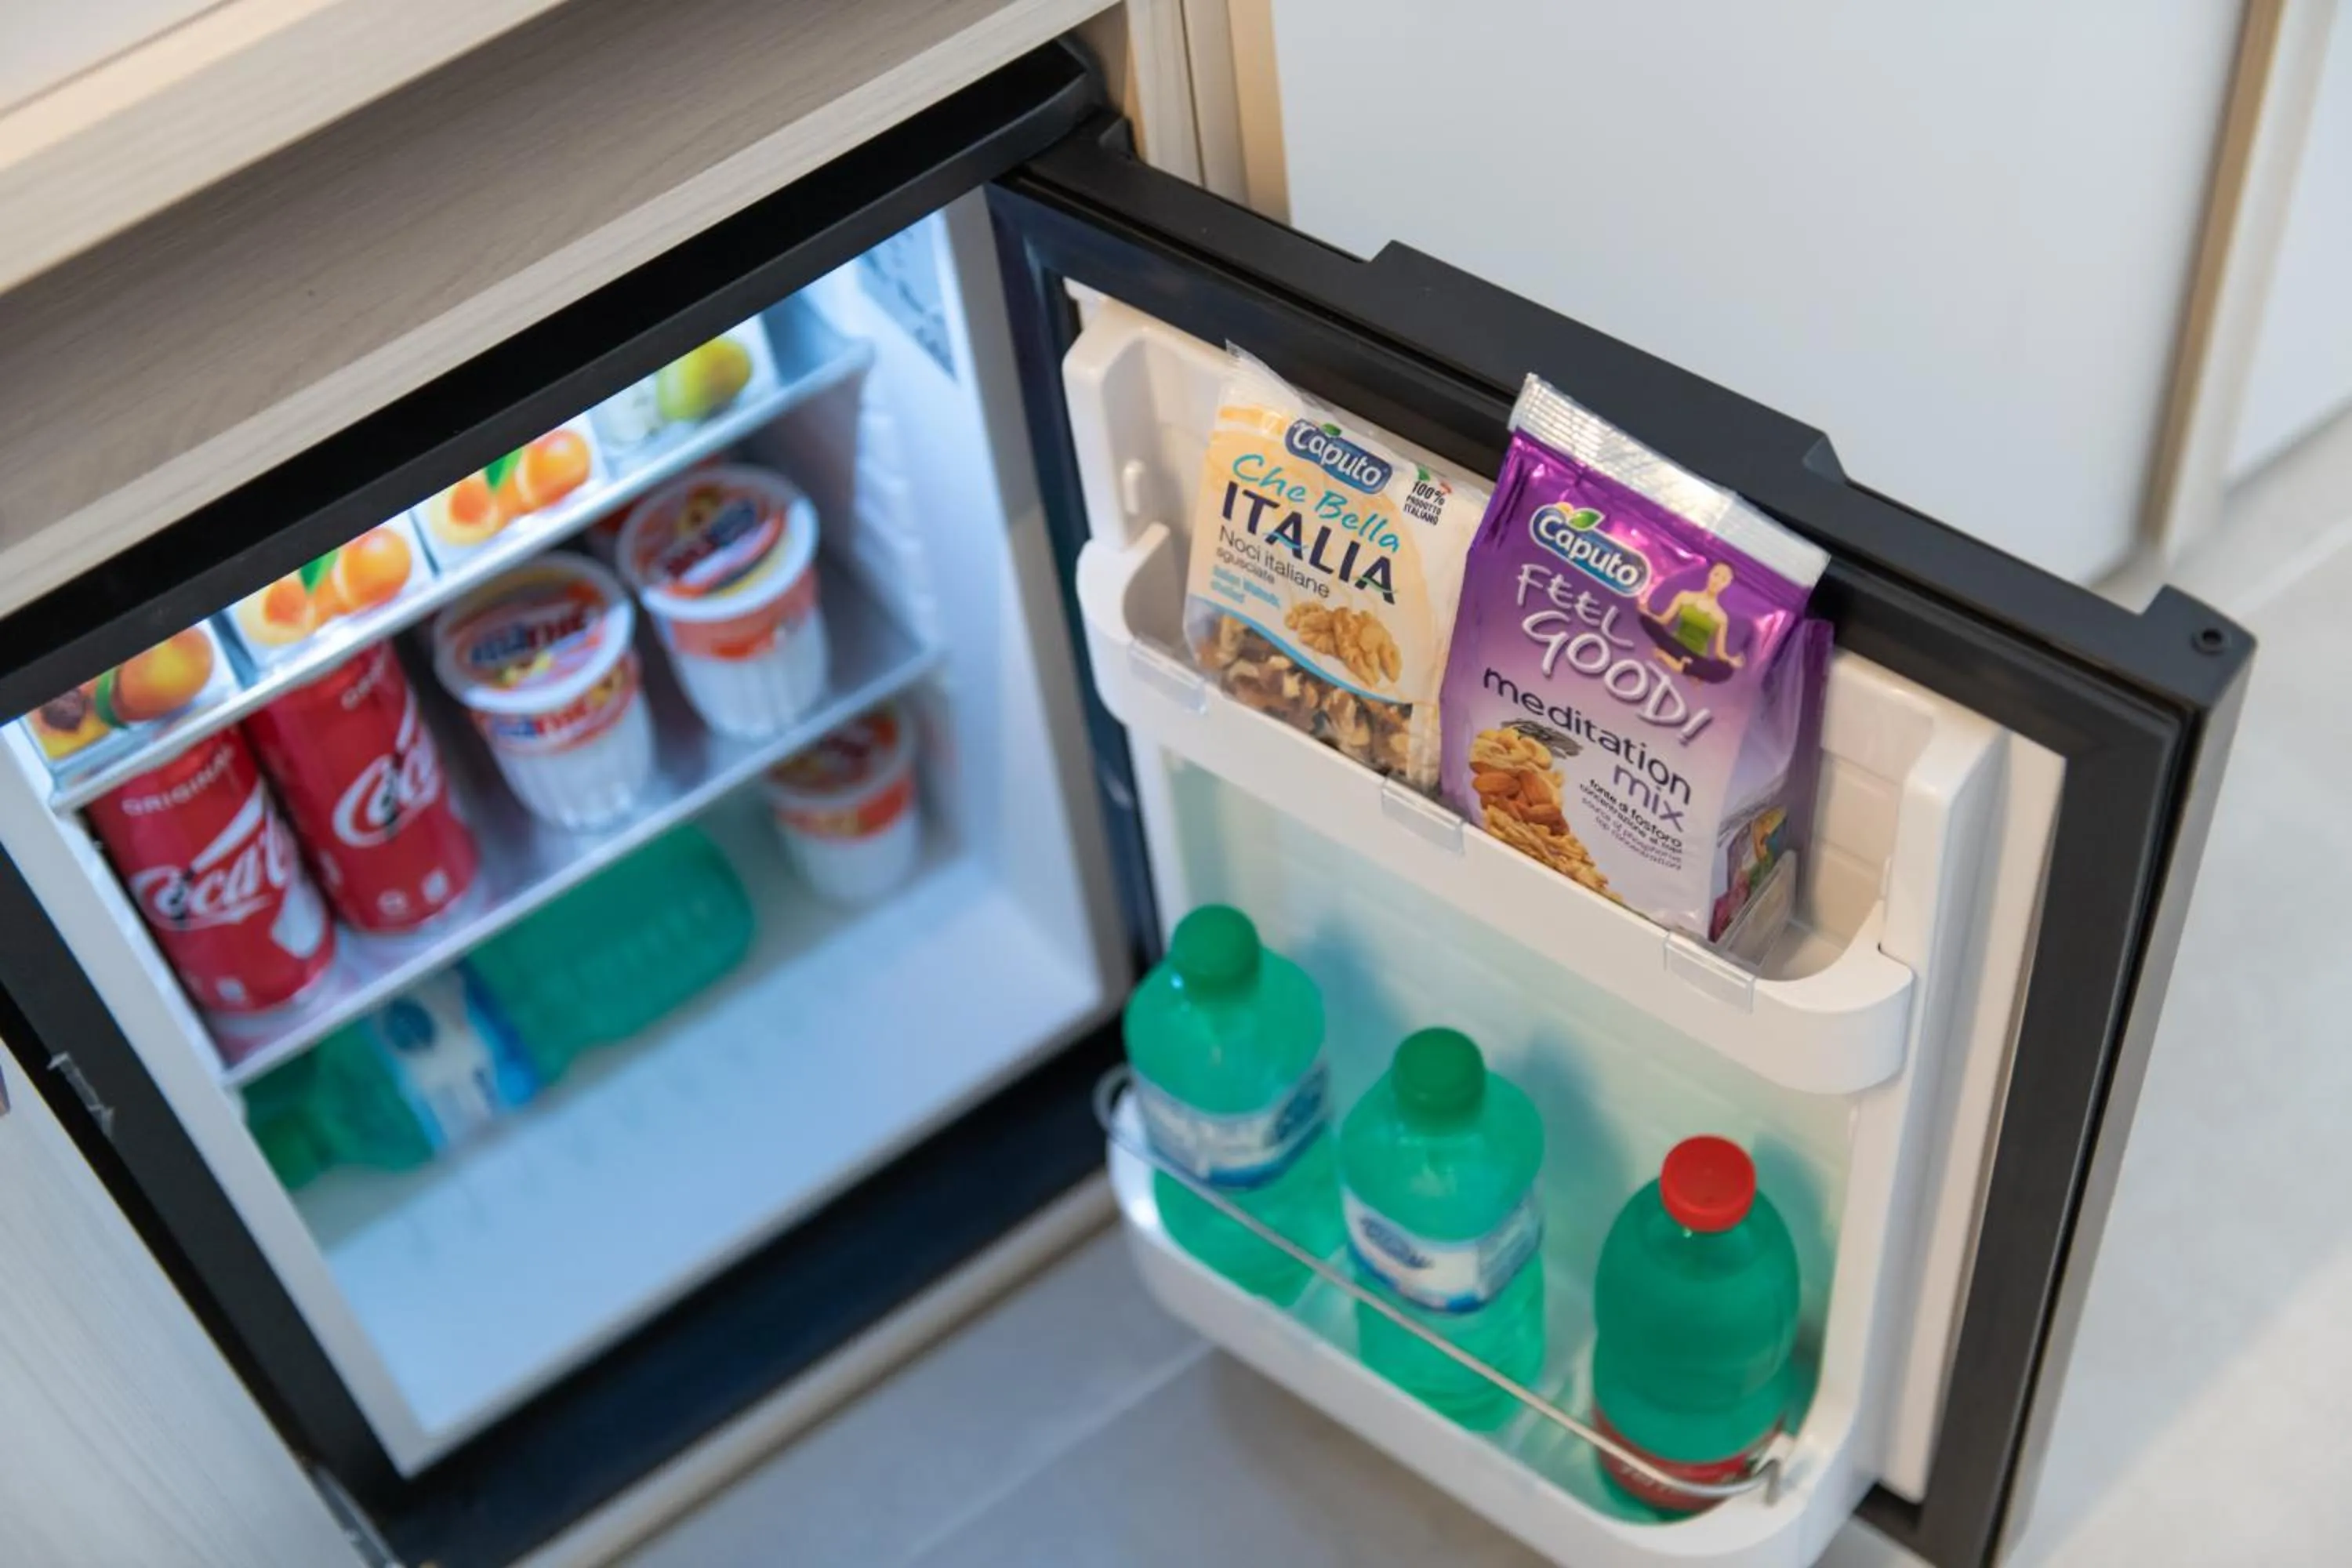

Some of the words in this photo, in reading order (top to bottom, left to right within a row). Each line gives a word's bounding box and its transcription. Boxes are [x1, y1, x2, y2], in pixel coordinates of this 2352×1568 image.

[1291, 421, 1382, 488] Caputo
[1232, 454, 1306, 503] Che
[1314, 490, 1400, 553] Bella
[1412, 481, 1445, 506] 100%
[1219, 524, 1261, 561] Noci
[1265, 550, 1330, 599] italiane
[1221, 481, 1396, 604] ITALIA
[1537, 513, 1639, 587] Caputo
[1483, 667, 1691, 805] meditation
[1613, 764, 1684, 833] mix
